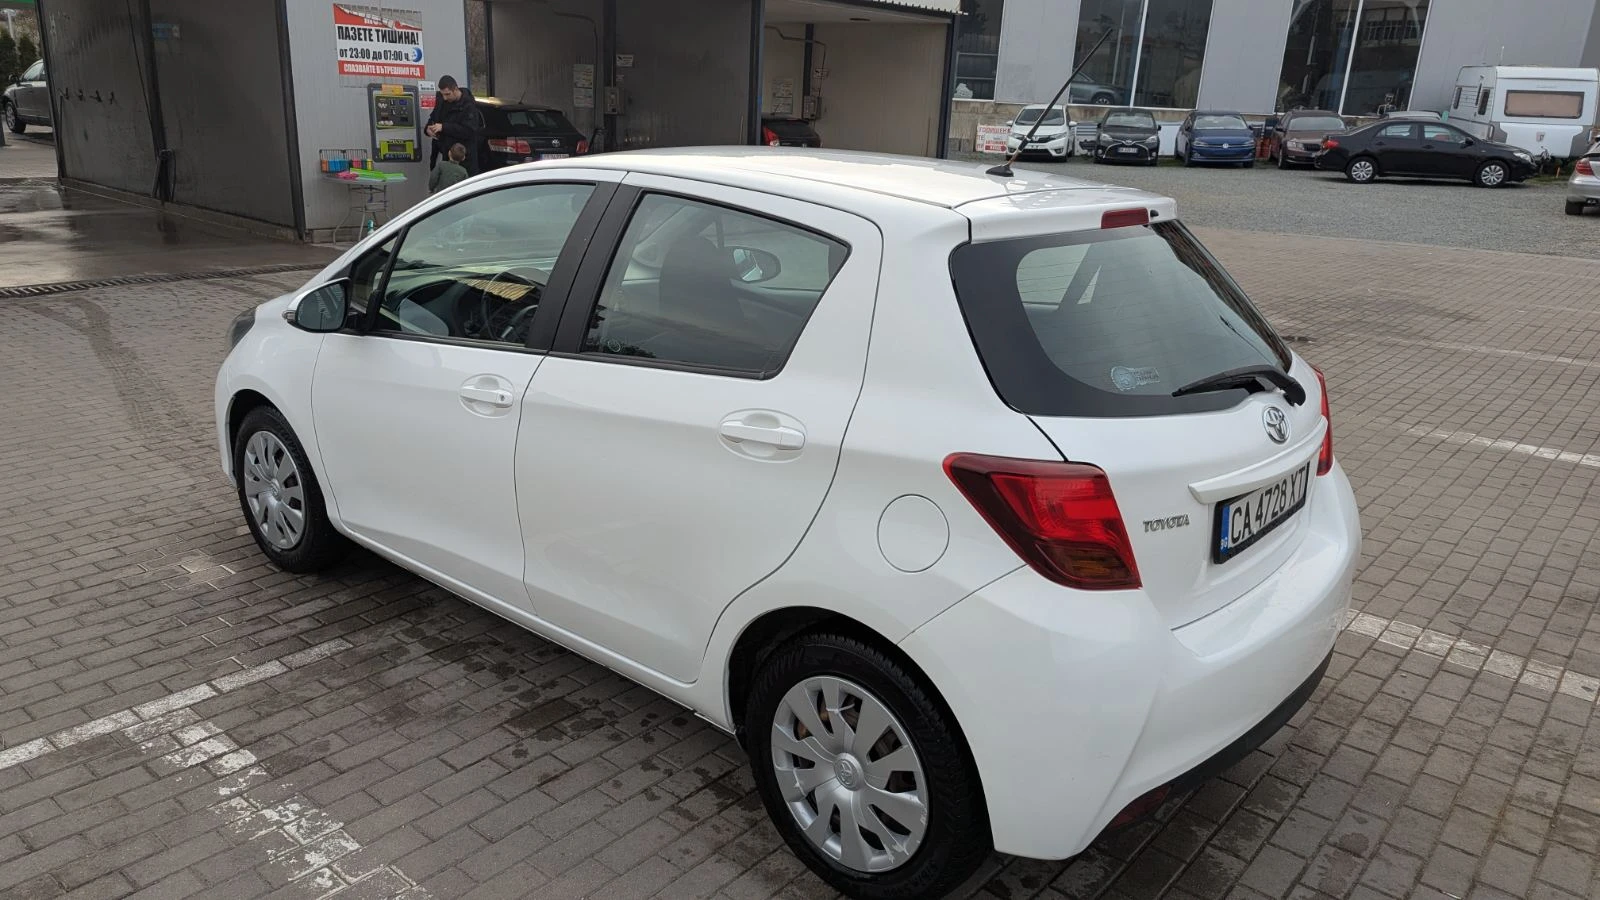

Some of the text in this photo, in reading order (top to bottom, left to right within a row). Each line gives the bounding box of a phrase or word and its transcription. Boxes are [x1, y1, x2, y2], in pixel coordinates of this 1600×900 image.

[337, 26, 420, 45] ПАЗЕТЕ ТИШИНА!
[340, 48, 348, 58] от
[349, 47, 371, 60] 23:00
[372, 51, 382, 61] до
[384, 50, 403, 62] 07:00
[344, 63, 376, 74] СПАЗВАЙТЕ
[410, 68, 421, 77] РЕД
[1231, 466, 1306, 544] CA 4728 XT
[1143, 513, 1190, 533] TOYOTA
